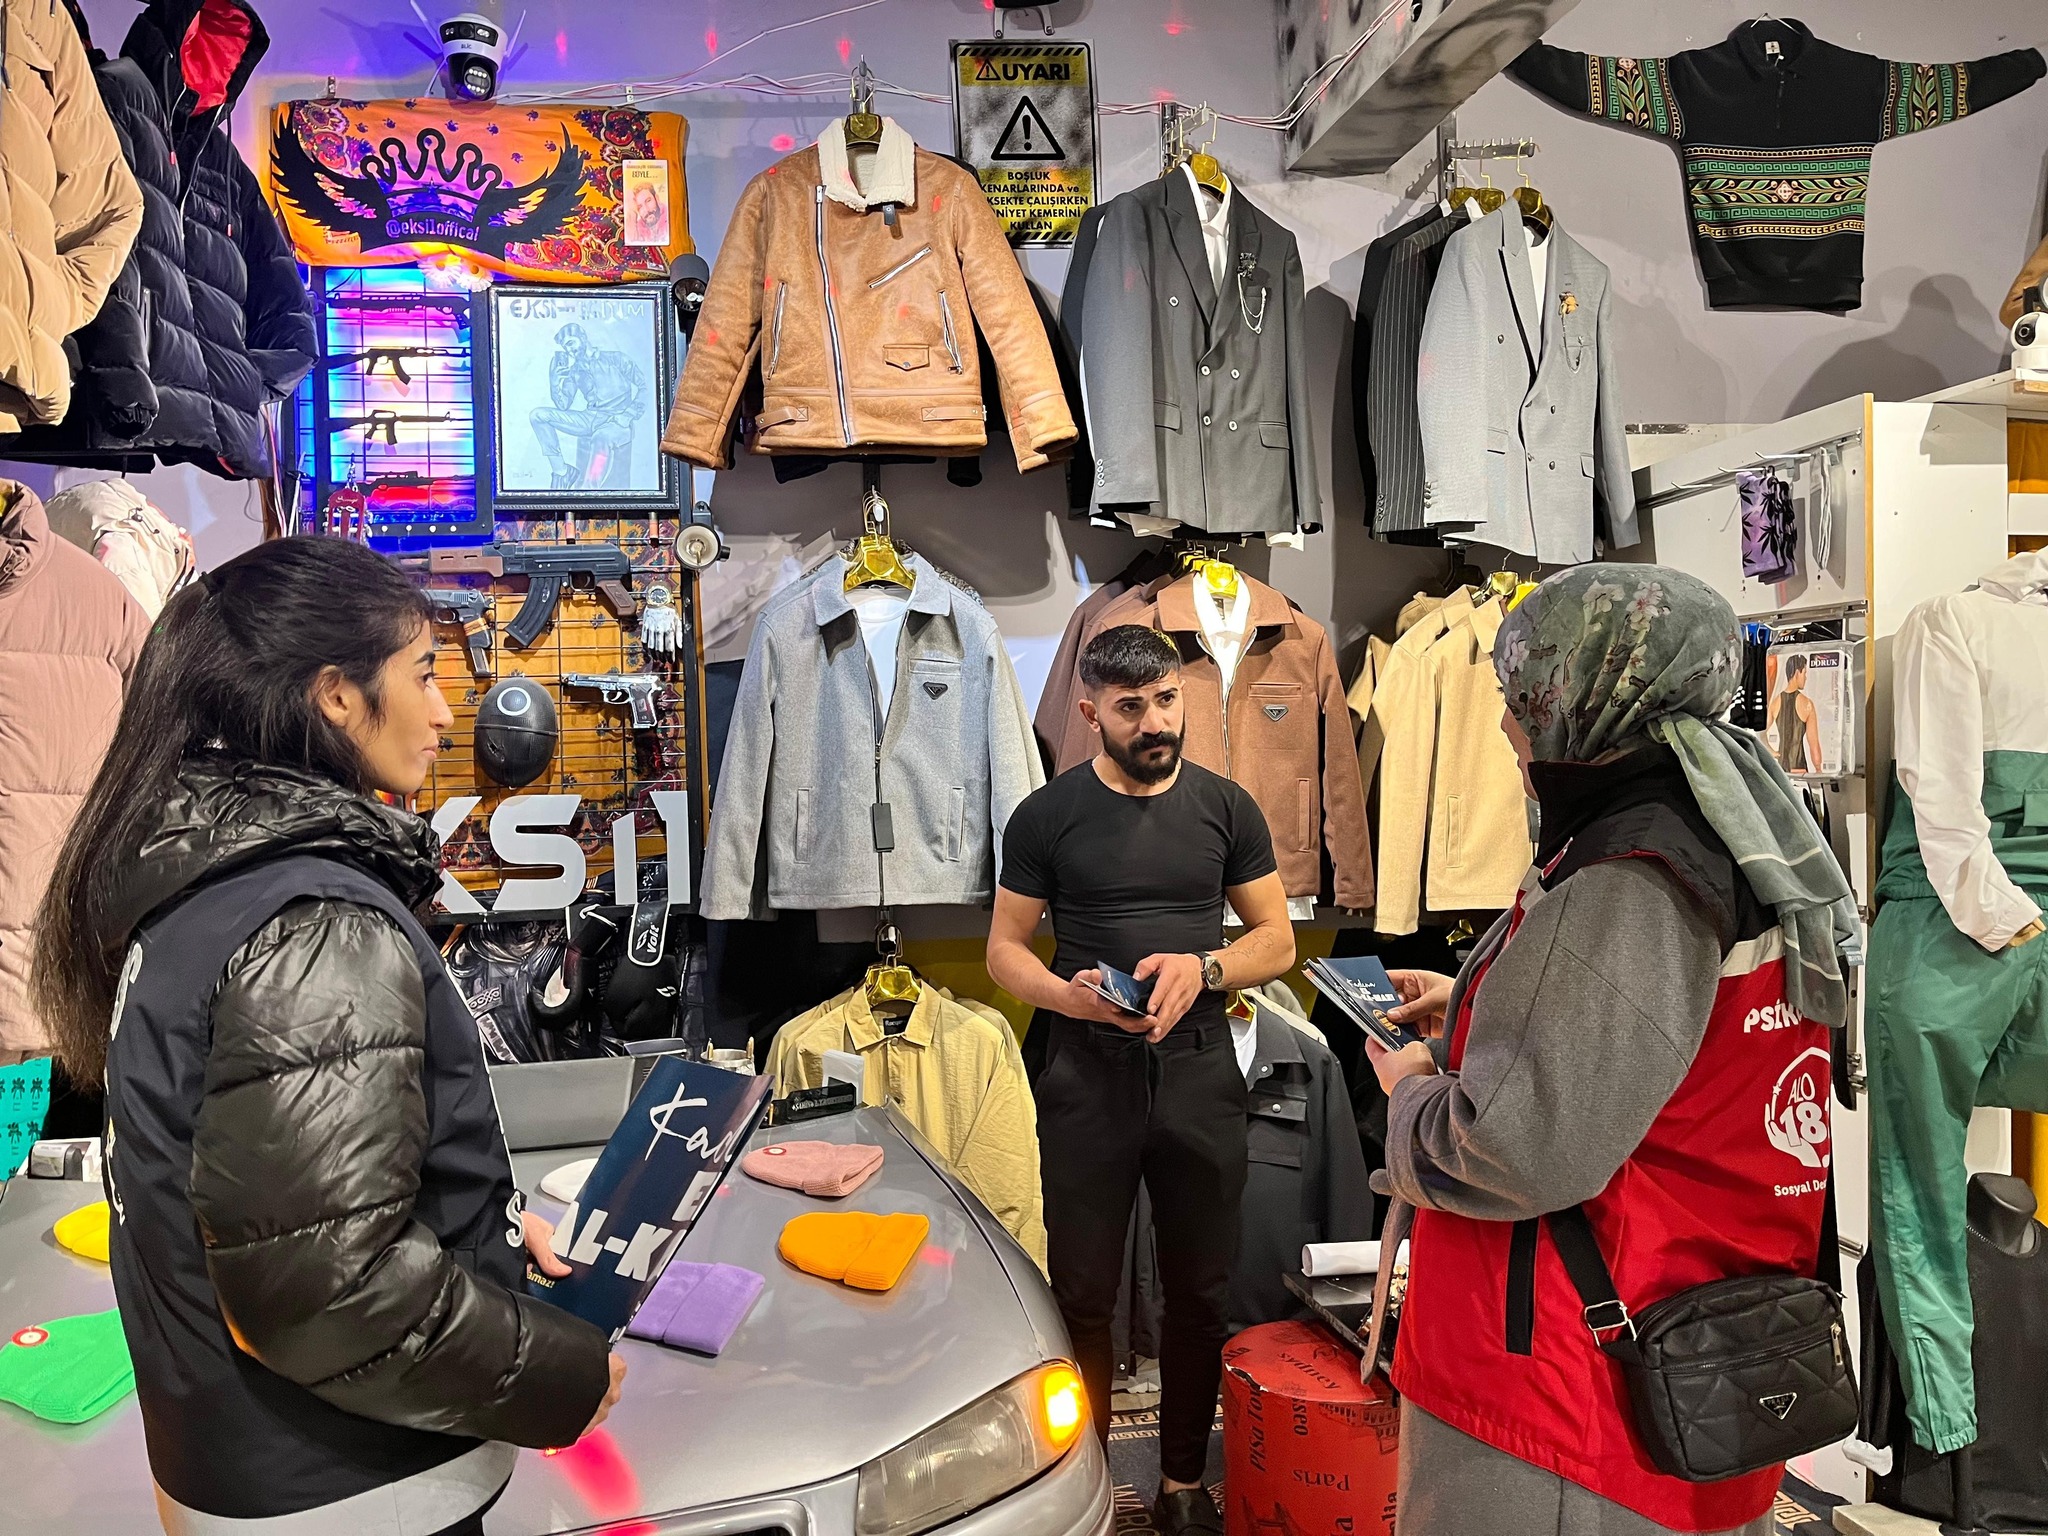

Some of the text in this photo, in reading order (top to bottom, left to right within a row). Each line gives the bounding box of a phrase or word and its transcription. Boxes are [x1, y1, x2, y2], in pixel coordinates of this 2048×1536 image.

[1002, 63, 1070, 81] UYARI
[1007, 171, 1051, 183] BOŞLUK
[980, 184, 1065, 193] KENARLARINDA
[1026, 196, 1089, 208] ÇALIŞIRKEN
[993, 206, 1081, 218] NİYET KEMERİNİ
[1010, 221, 1053, 230] KULLAN
[1810, 658, 1838, 668] DORUK
[1787, 1072, 1816, 1106] ALO
[1779, 1097, 1829, 1148] 18
[1773, 1180, 1812, 1197] Sosyal
[1293, 1468, 1351, 1492] Paris
